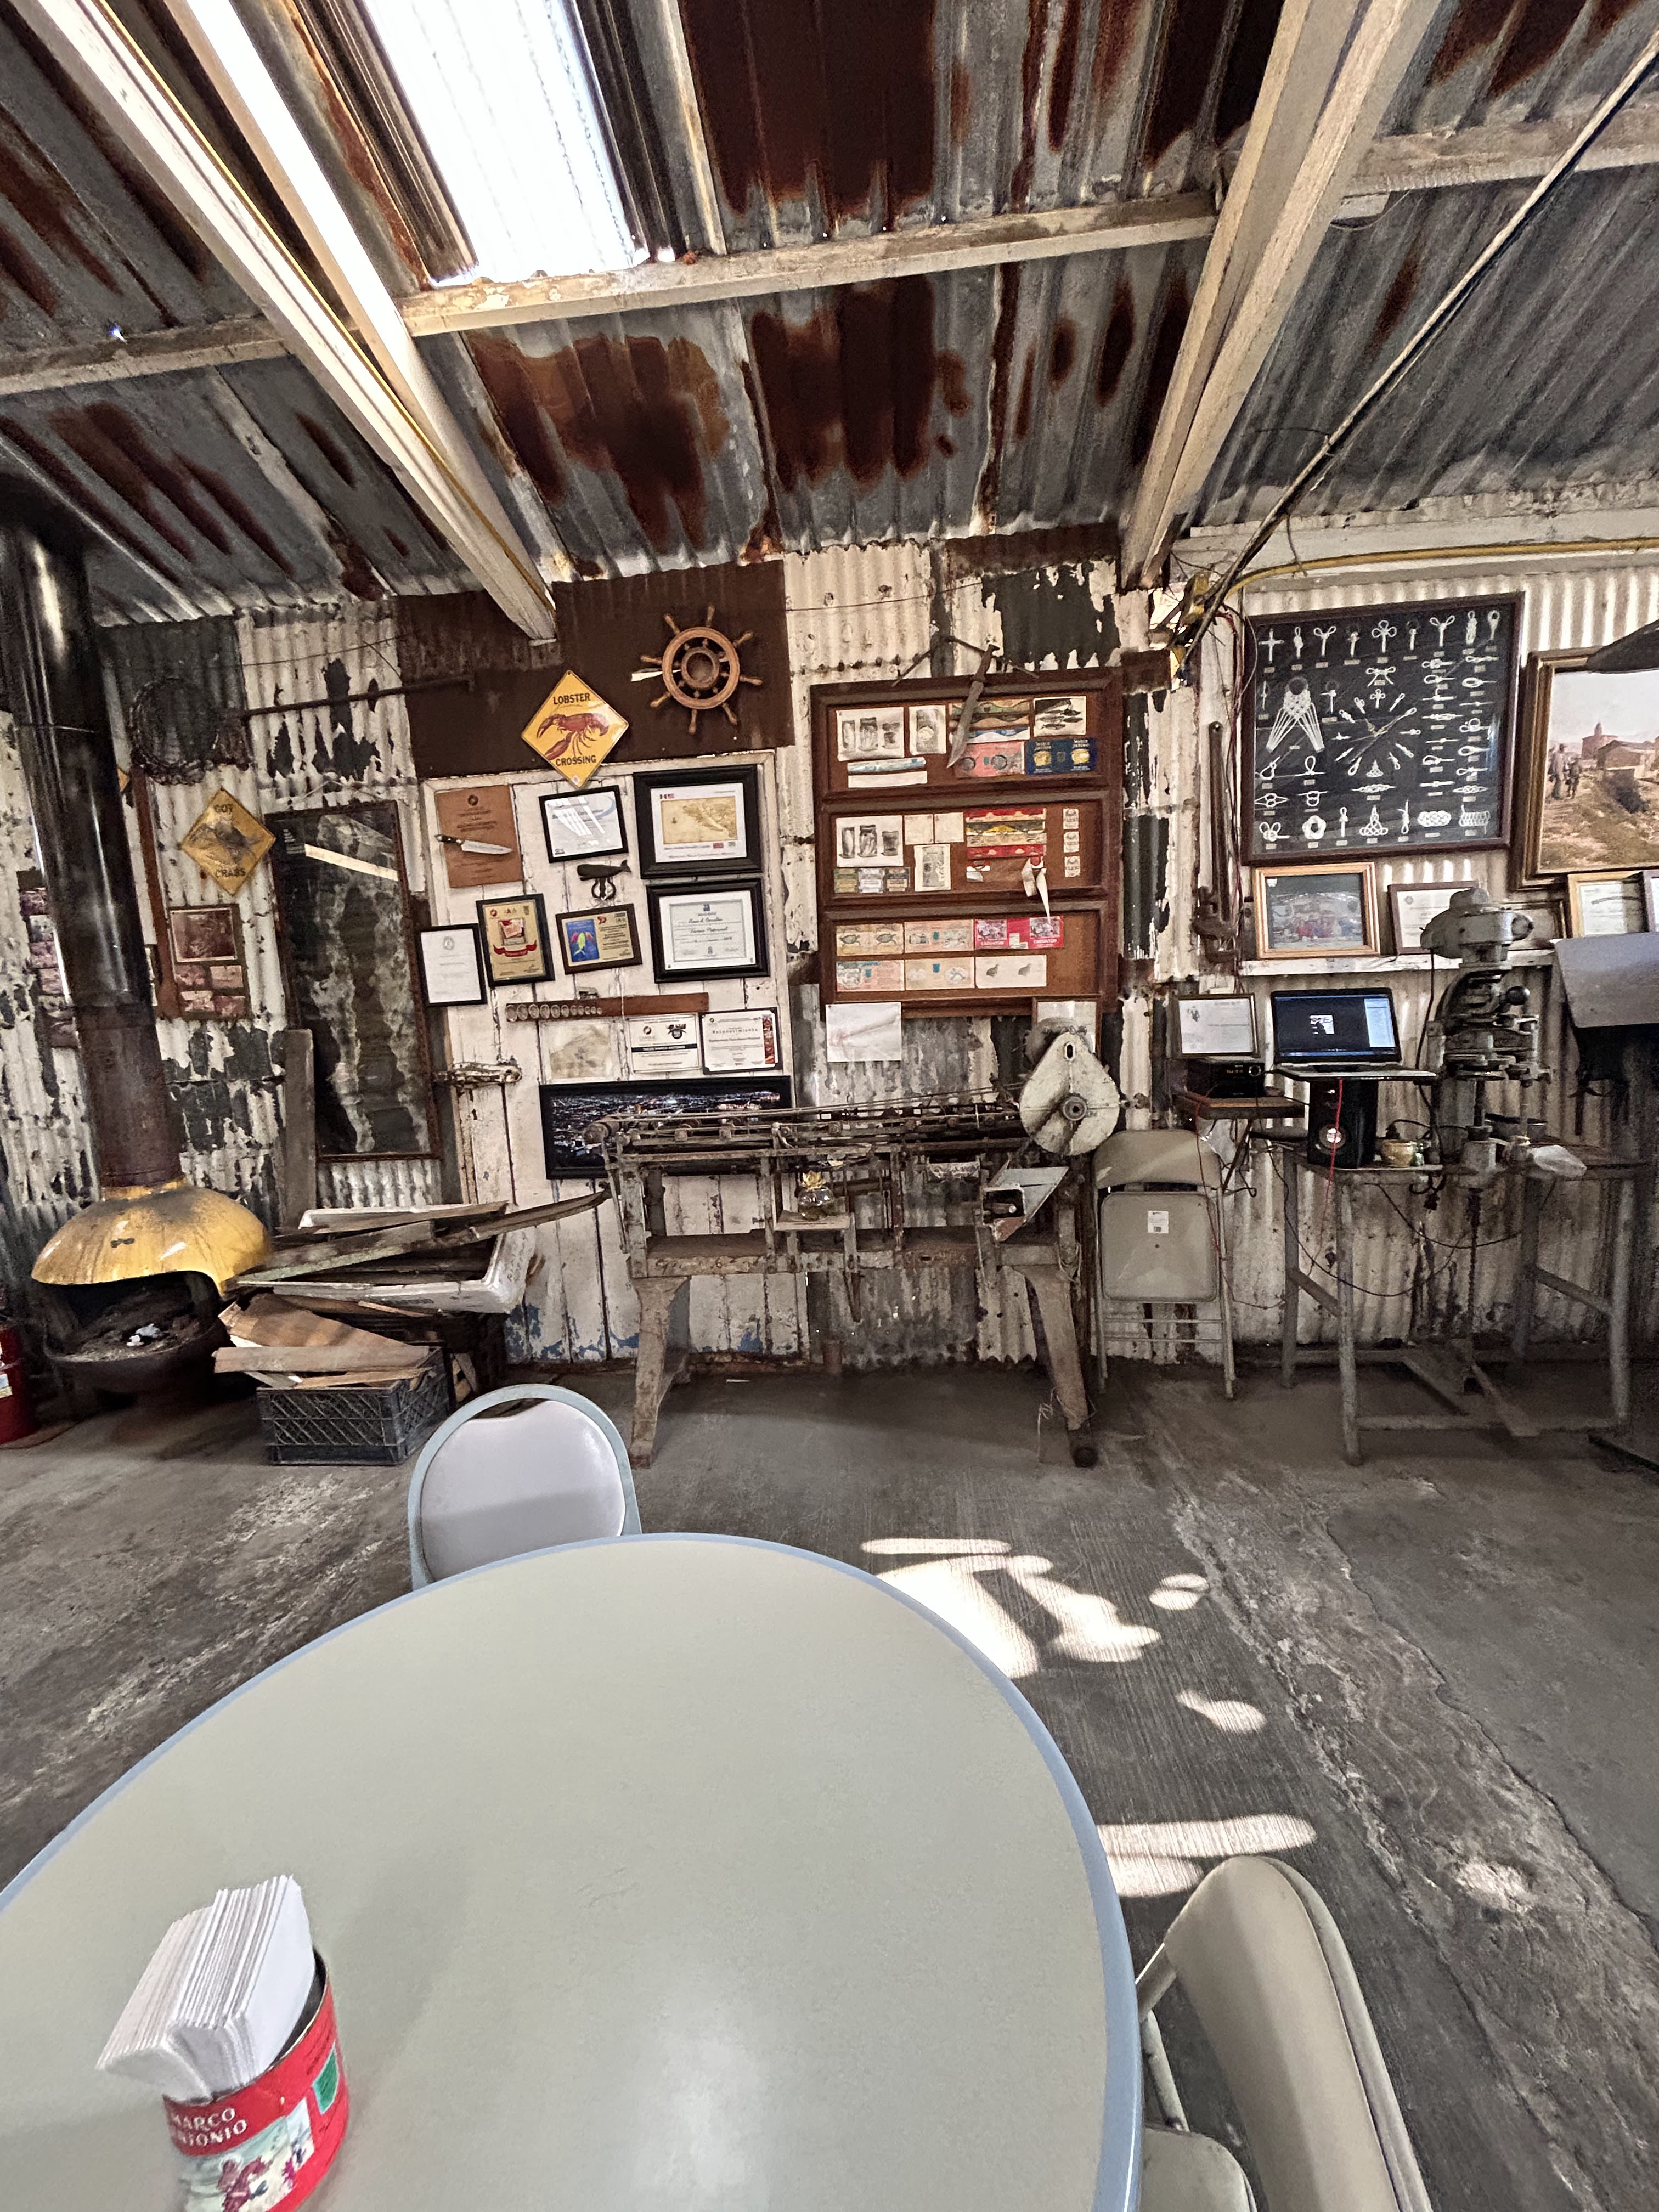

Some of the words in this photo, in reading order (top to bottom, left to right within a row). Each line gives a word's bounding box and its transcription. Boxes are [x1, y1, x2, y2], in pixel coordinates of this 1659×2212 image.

[553, 692, 591, 705] LOBSTER
[556, 755, 596, 766] CROSSING
[214, 804, 233, 813] GOT
[215, 868, 246, 878] CRABS
